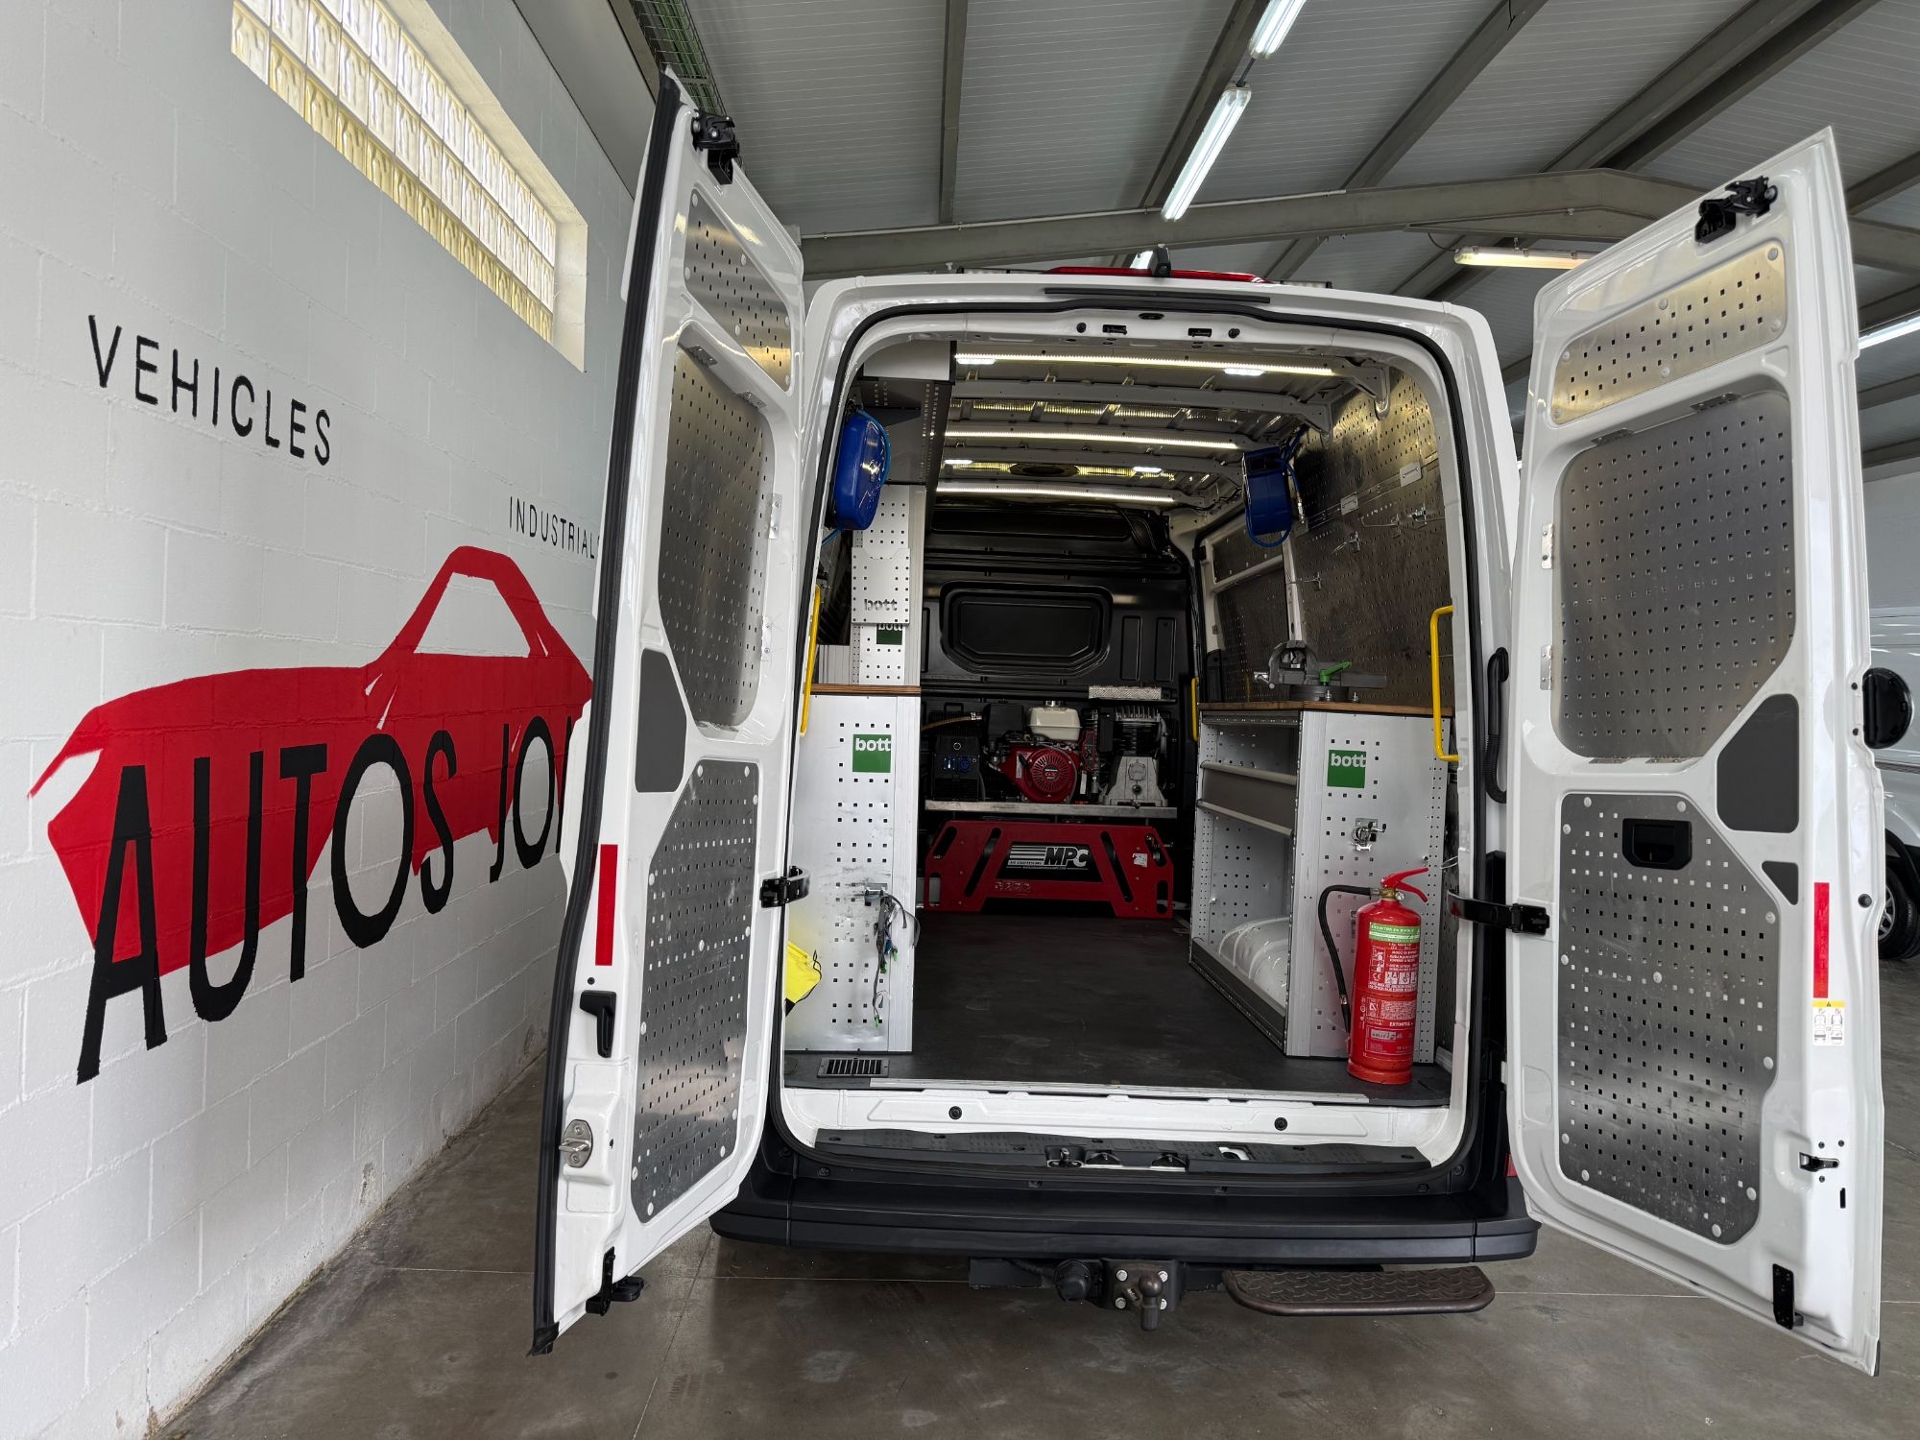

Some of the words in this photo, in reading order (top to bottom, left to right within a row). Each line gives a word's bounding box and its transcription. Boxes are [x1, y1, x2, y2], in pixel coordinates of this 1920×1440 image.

[87, 314, 332, 467] VEHICLES
[508, 495, 600, 560] INDUSTRIAL
[864, 598, 898, 612] bott
[855, 737, 892, 752] bott
[1330, 752, 1367, 768] bott
[1043, 846, 1090, 868] MPC
[76, 729, 458, 1086] AUTOS
